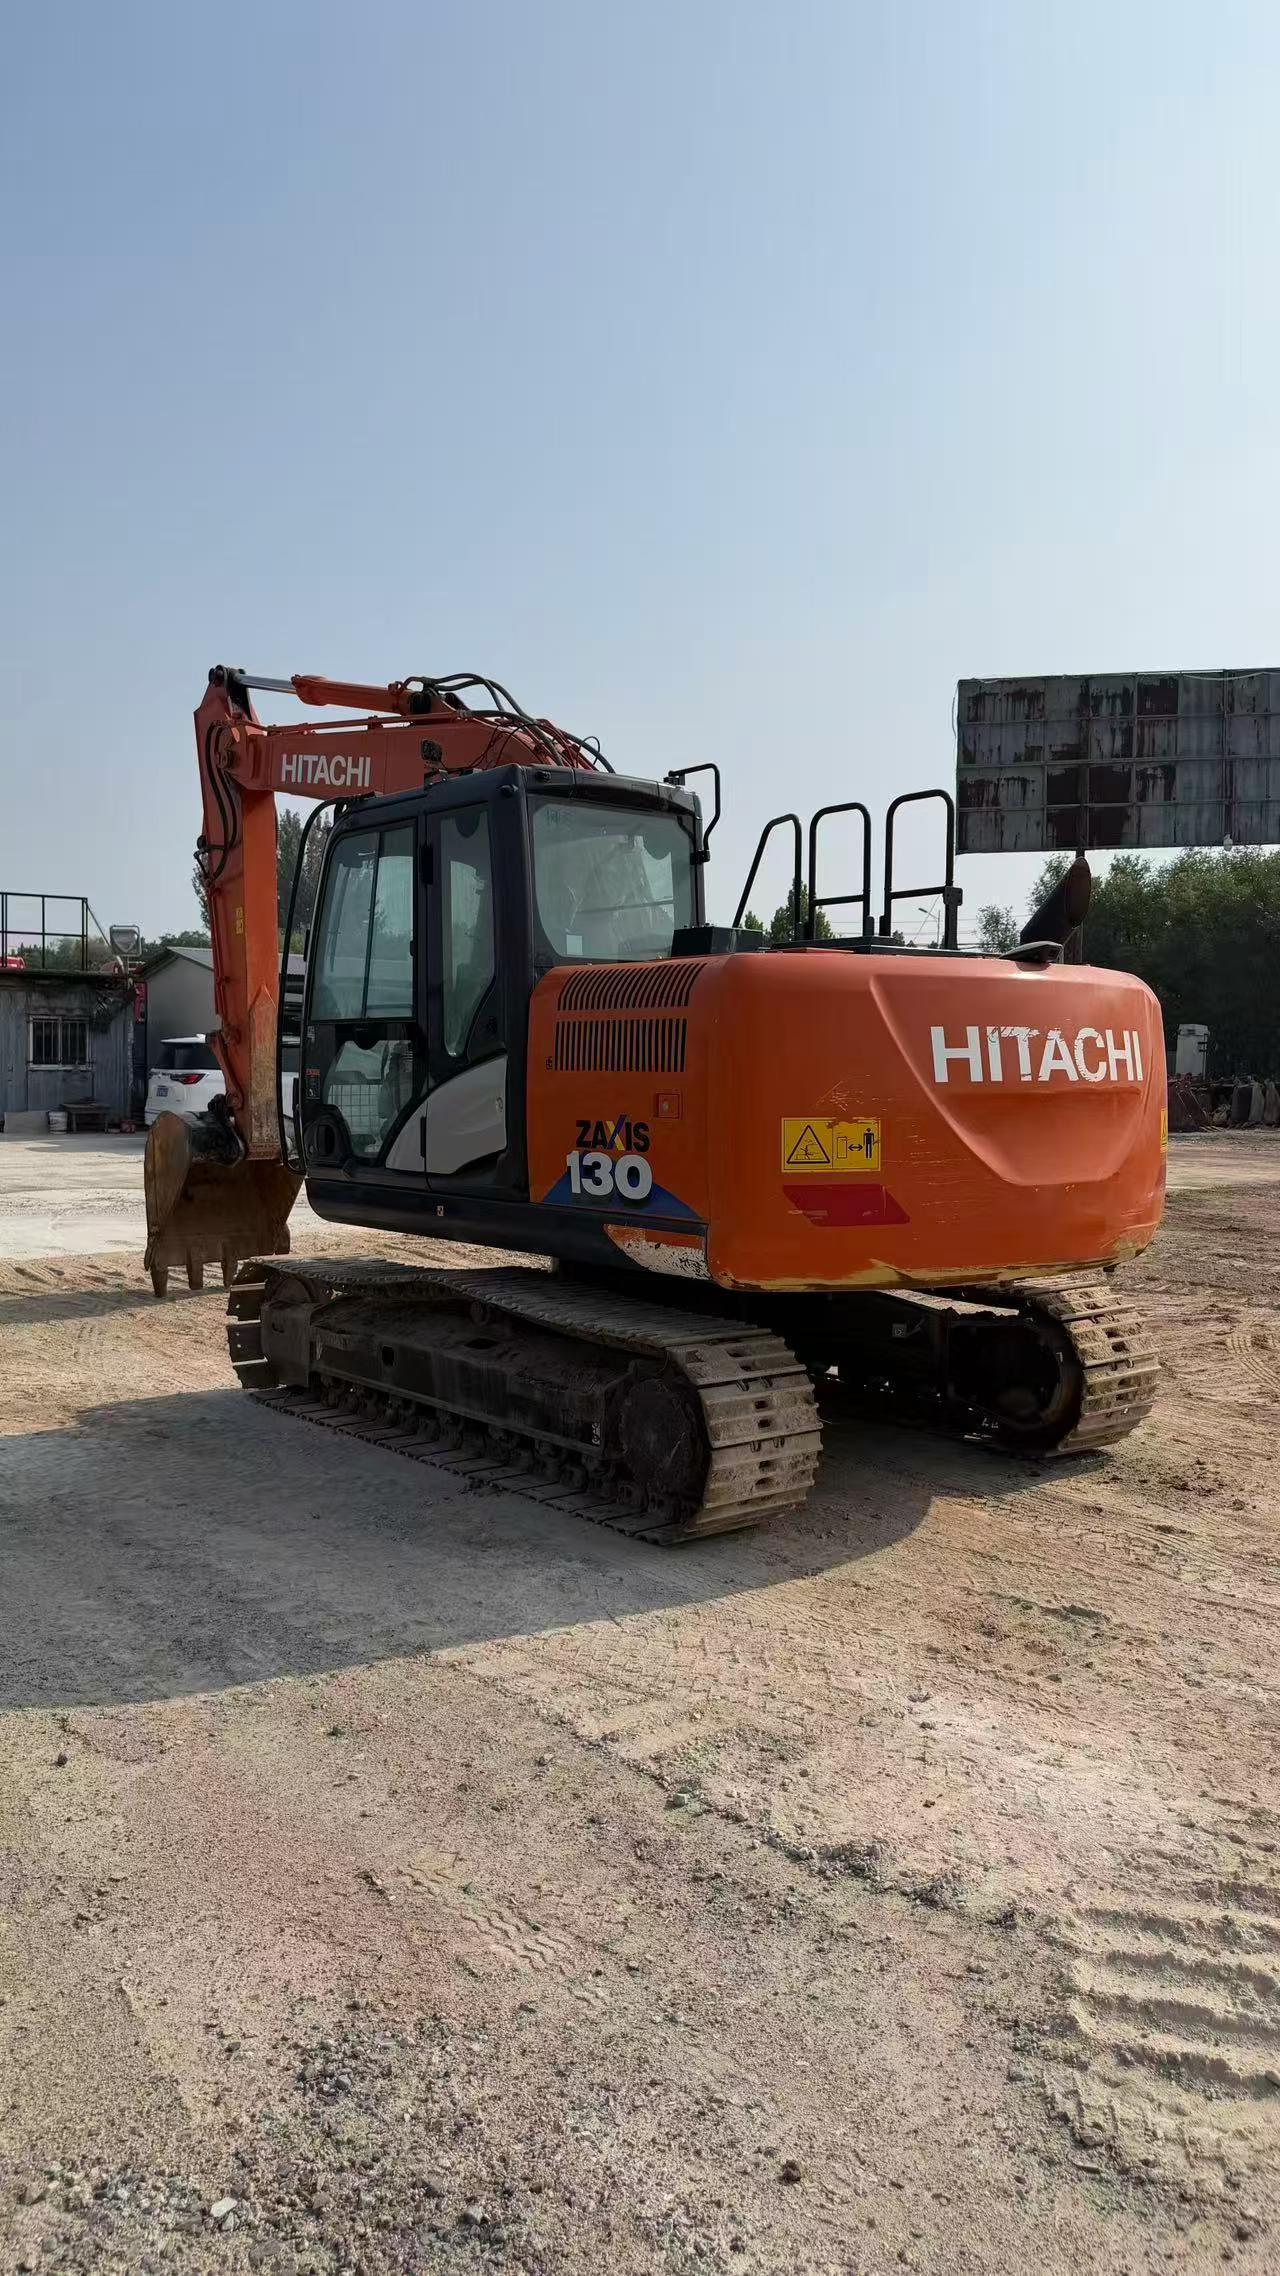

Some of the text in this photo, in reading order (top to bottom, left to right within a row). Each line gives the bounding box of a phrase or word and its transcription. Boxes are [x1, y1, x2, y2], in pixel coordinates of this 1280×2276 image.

[281, 753, 371, 787] HITACHI
[930, 1026, 1144, 1083] HITACHI
[575, 1113, 650, 1152] ZAXIS
[566, 1150, 653, 1200] 130
